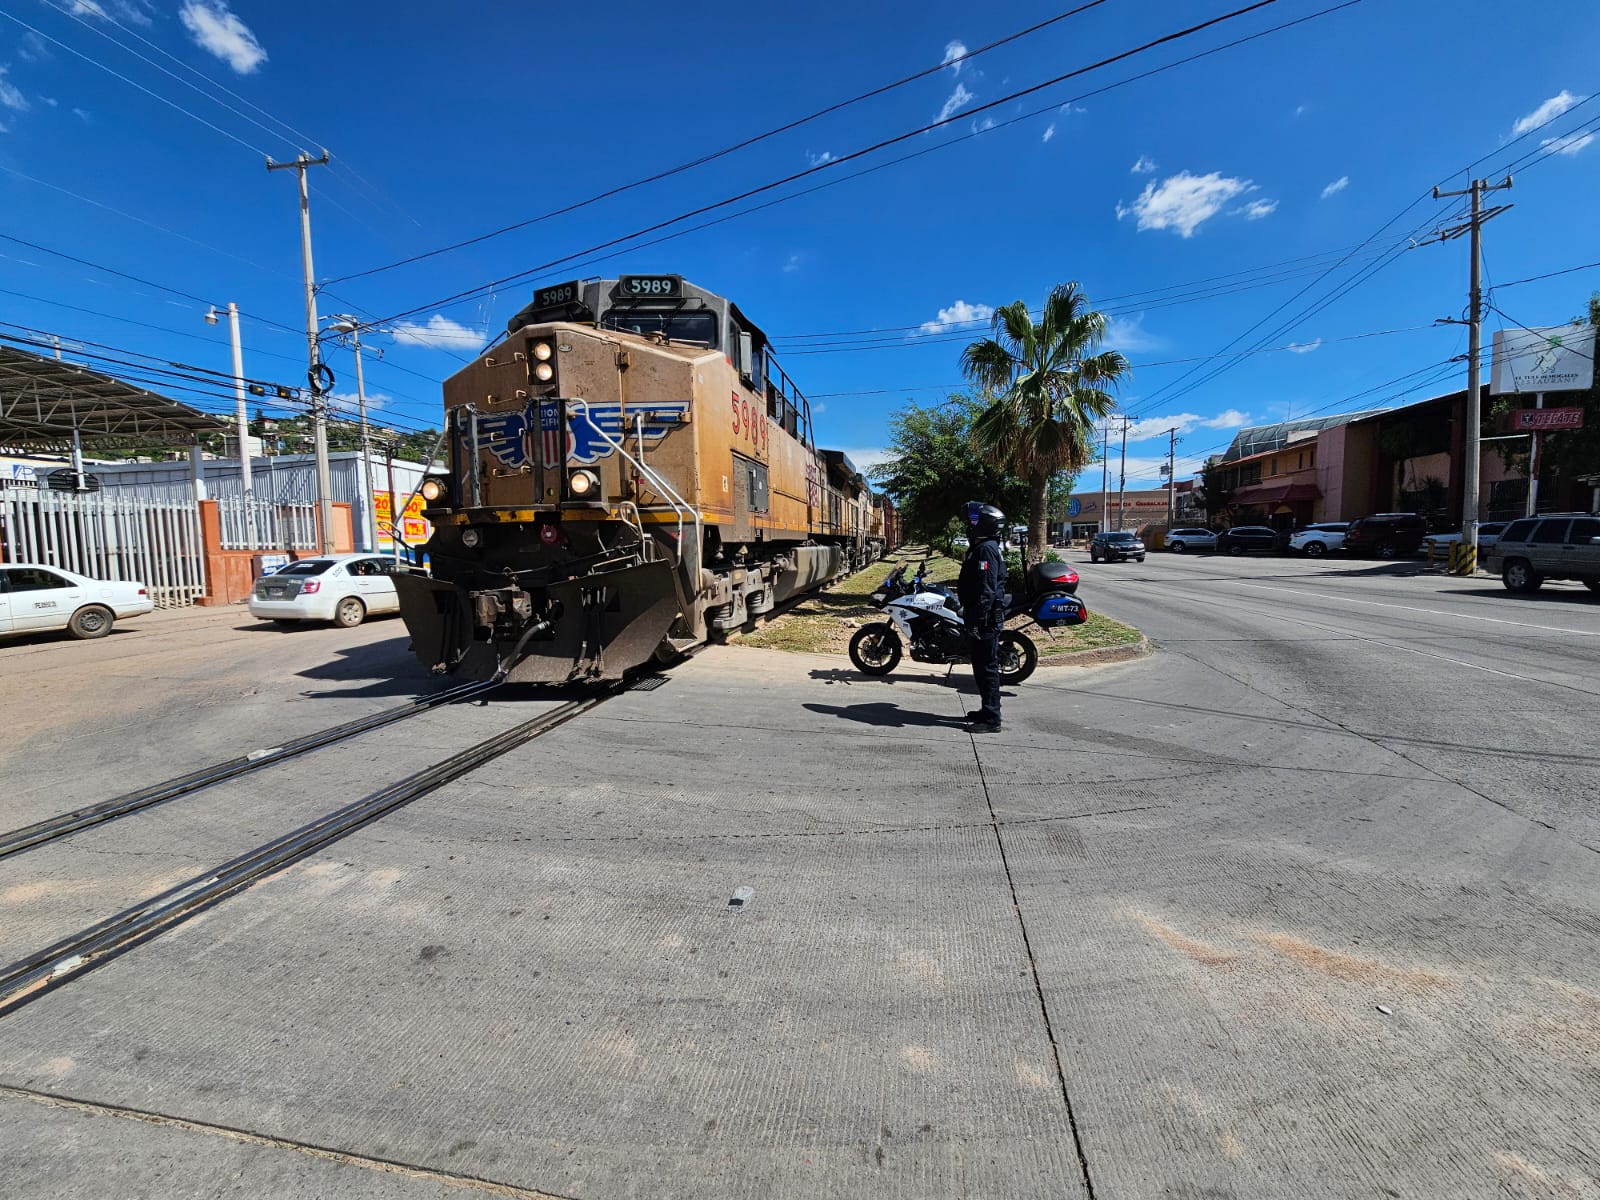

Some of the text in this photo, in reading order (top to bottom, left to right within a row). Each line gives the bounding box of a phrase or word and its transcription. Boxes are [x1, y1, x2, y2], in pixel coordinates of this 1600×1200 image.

[631, 279, 672, 294] 5989
[542, 287, 572, 305] 5989
[731, 390, 767, 450] 5989
[1535, 411, 1580, 426] TECATE
[374, 498, 388, 510] 20
[1057, 604, 1079, 613] MT-73
